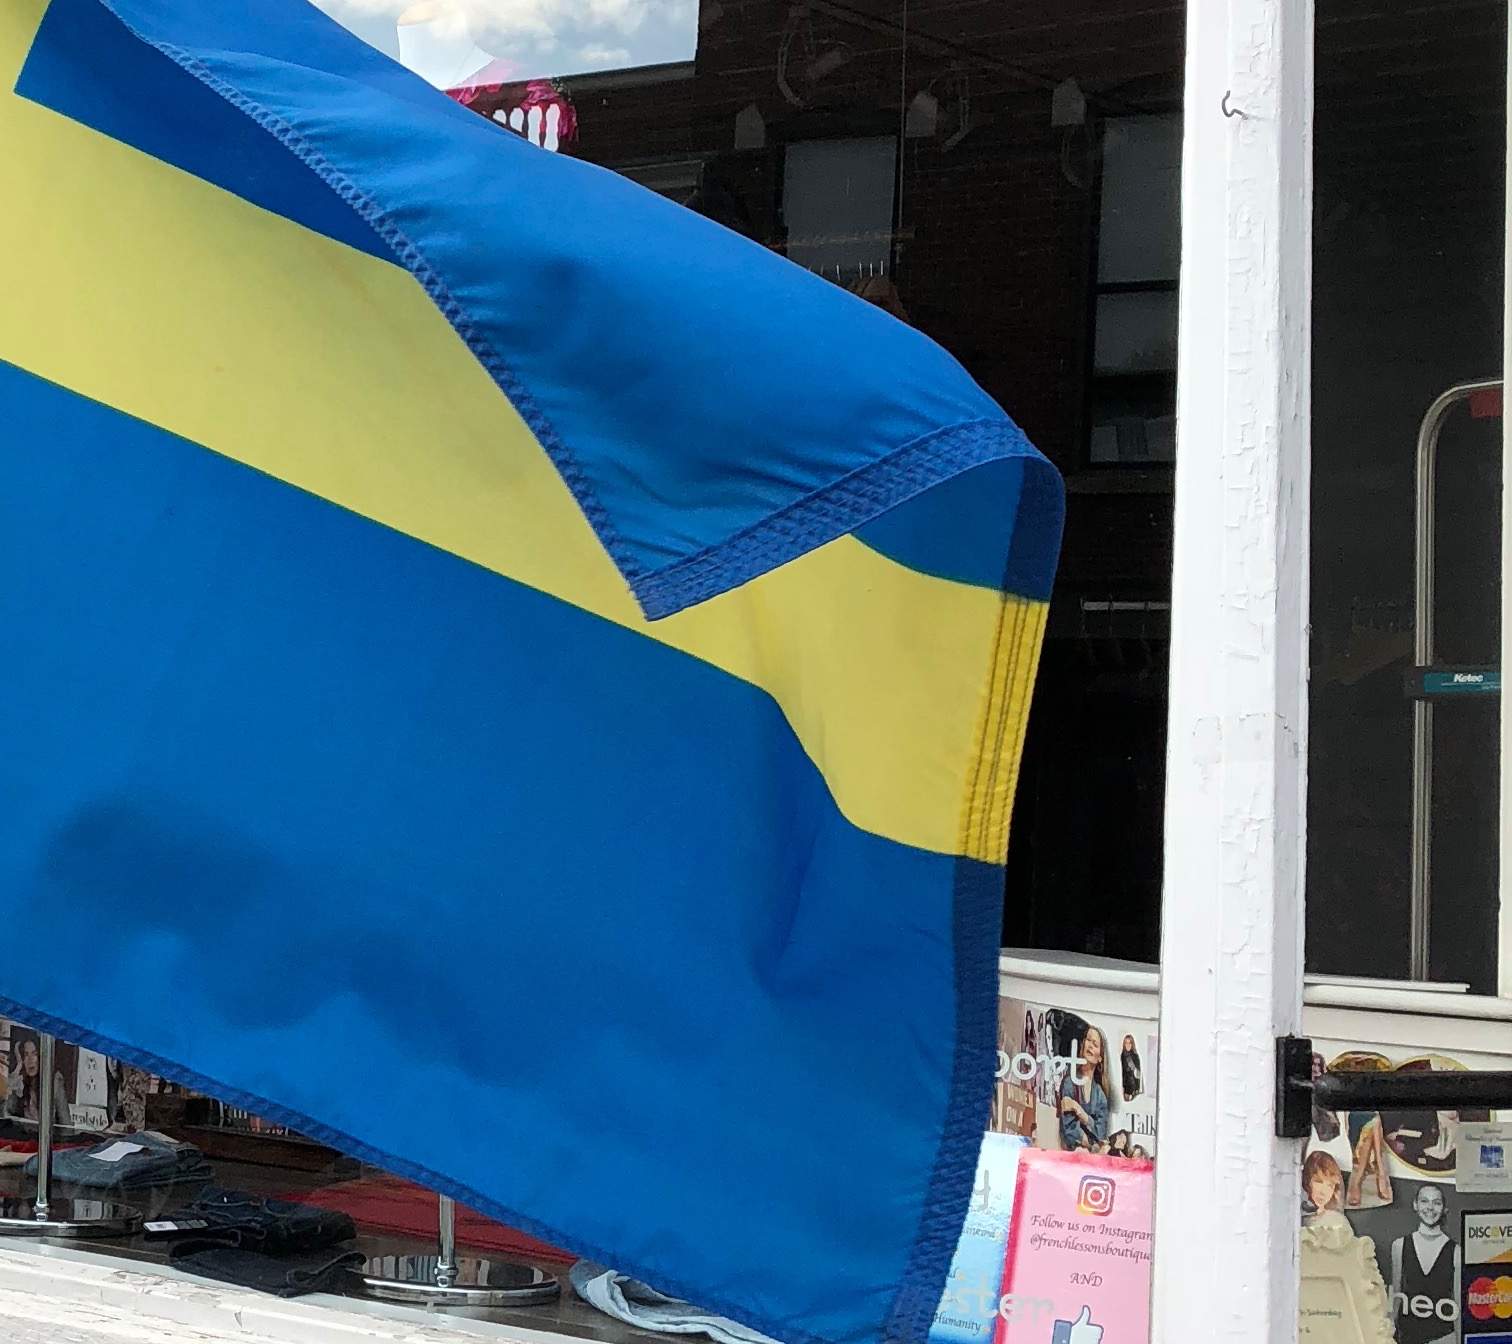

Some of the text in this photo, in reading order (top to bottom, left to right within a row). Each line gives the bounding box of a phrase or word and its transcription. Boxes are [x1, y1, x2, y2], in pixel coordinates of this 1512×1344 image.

[1030, 1214, 1065, 1231] Follow
[1068, 1222, 1080, 1233] us
[1082, 1224, 1096, 1234] on
[1069, 1272, 1103, 1287] AND
